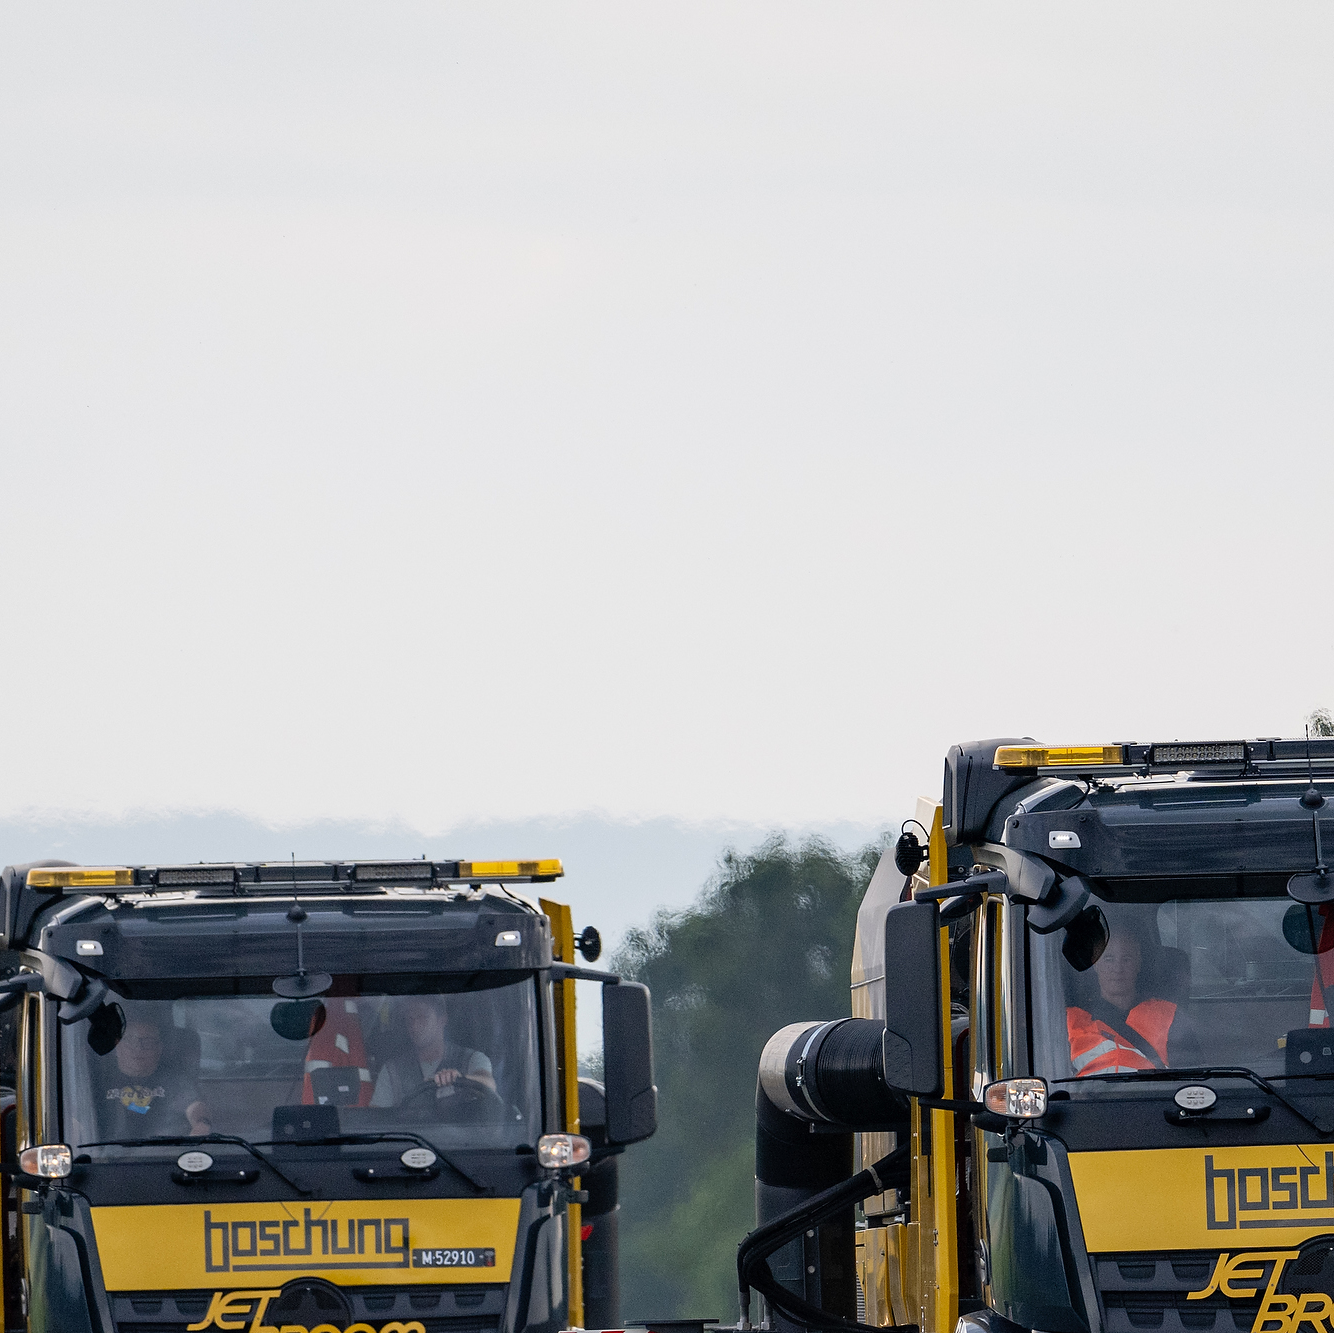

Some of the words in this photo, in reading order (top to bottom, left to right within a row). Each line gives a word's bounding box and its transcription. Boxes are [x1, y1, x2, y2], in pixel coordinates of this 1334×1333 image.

[205, 1208, 410, 1273] boschung
[1186, 1250, 1300, 1300] JET
[187, 1290, 282, 1331] JET
